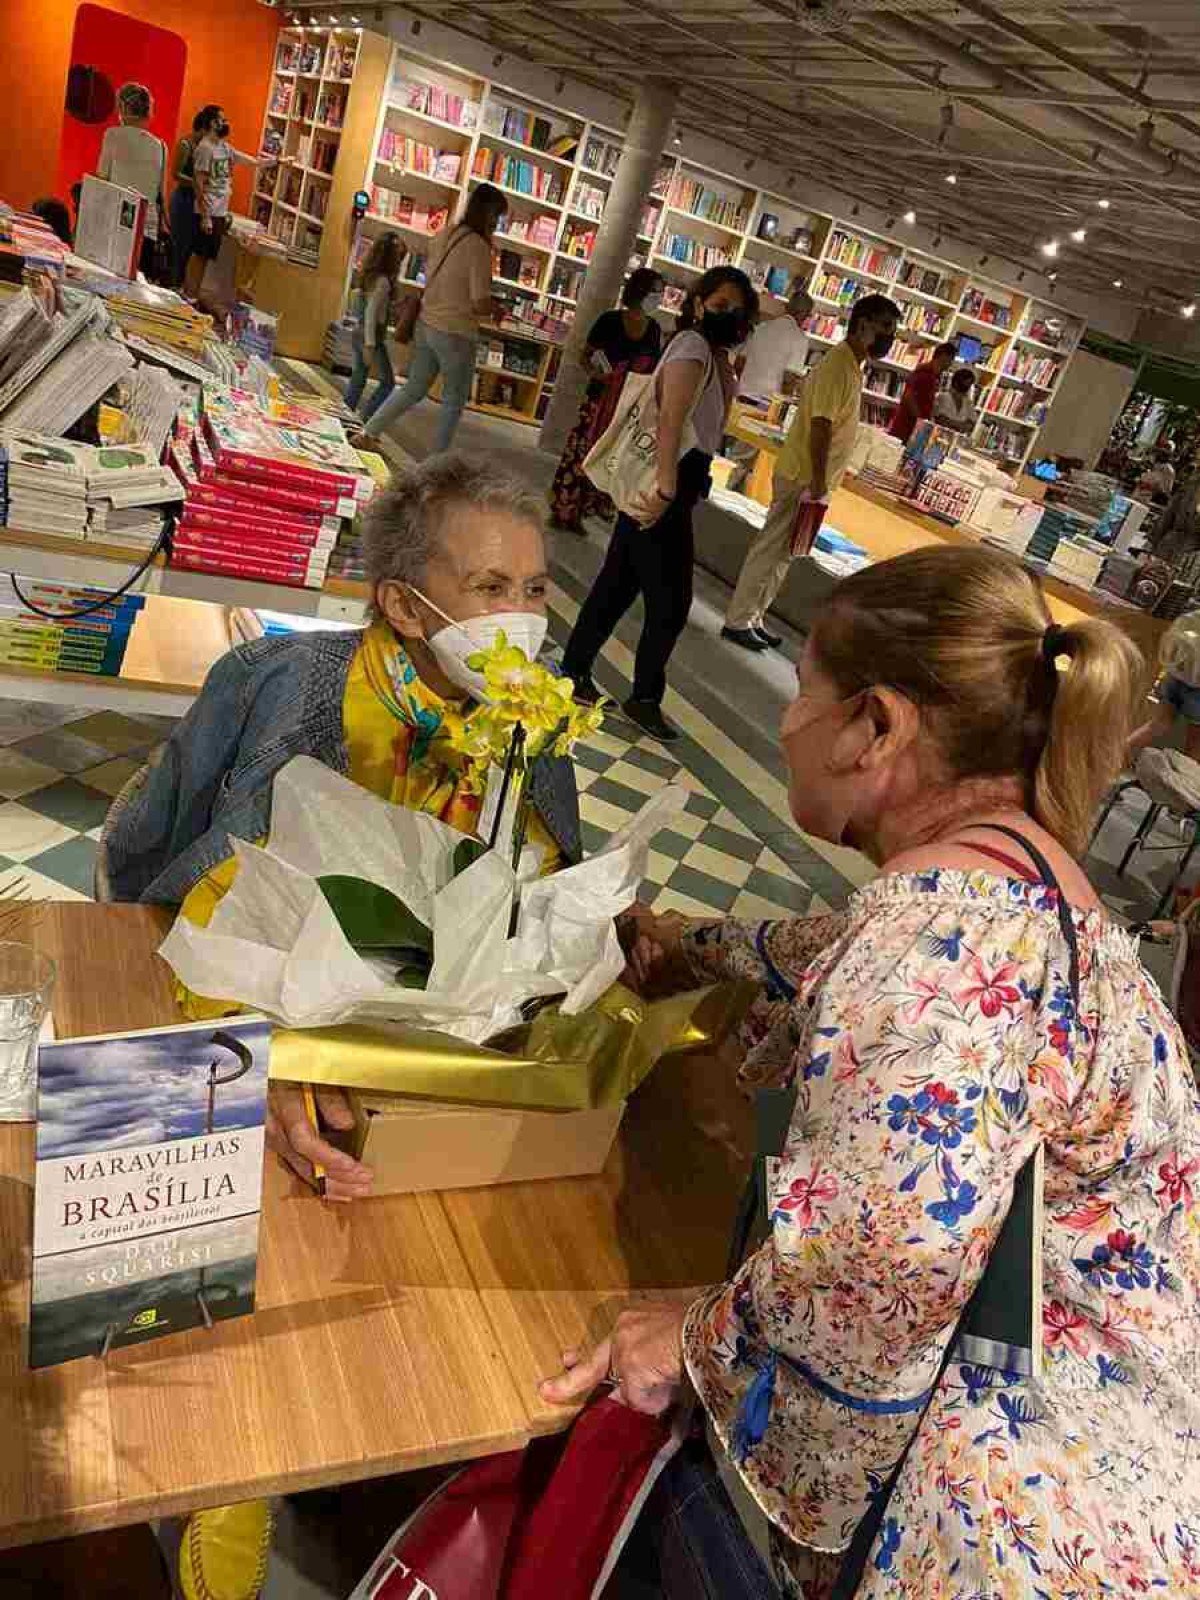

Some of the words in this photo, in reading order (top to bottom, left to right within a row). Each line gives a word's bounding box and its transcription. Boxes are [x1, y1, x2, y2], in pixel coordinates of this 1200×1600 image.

[64, 1136, 241, 1183] MARAVILHAS
[146, 1171, 163, 1184] de
[61, 1172, 236, 1227] BRASÍLIA
[91, 1220, 134, 1241] capital
